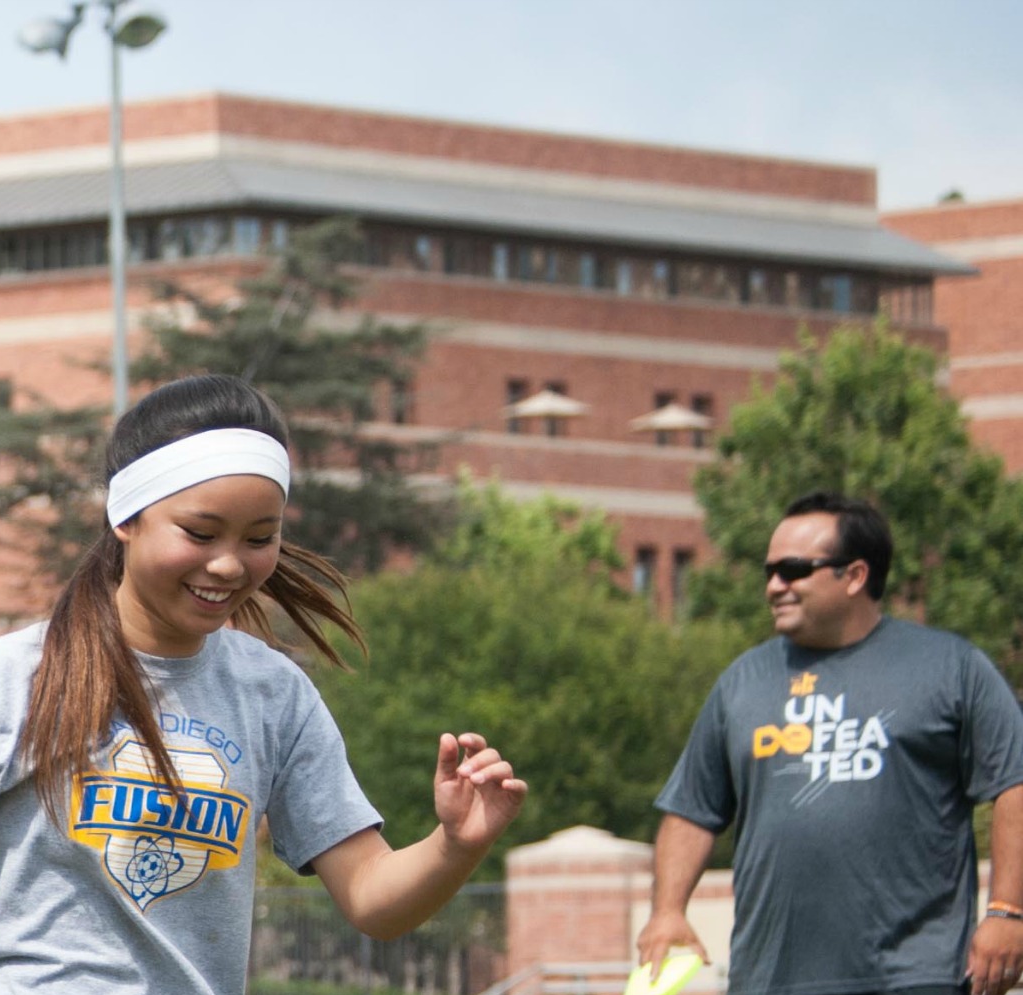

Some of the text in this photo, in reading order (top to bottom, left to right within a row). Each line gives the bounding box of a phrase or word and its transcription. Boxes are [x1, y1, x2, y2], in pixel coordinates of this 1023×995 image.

[784, 693, 845, 724] UN
[158, 712, 242, 765] DIEGO
[802, 748, 883, 782] TED
[80, 784, 244, 843] FUSION
